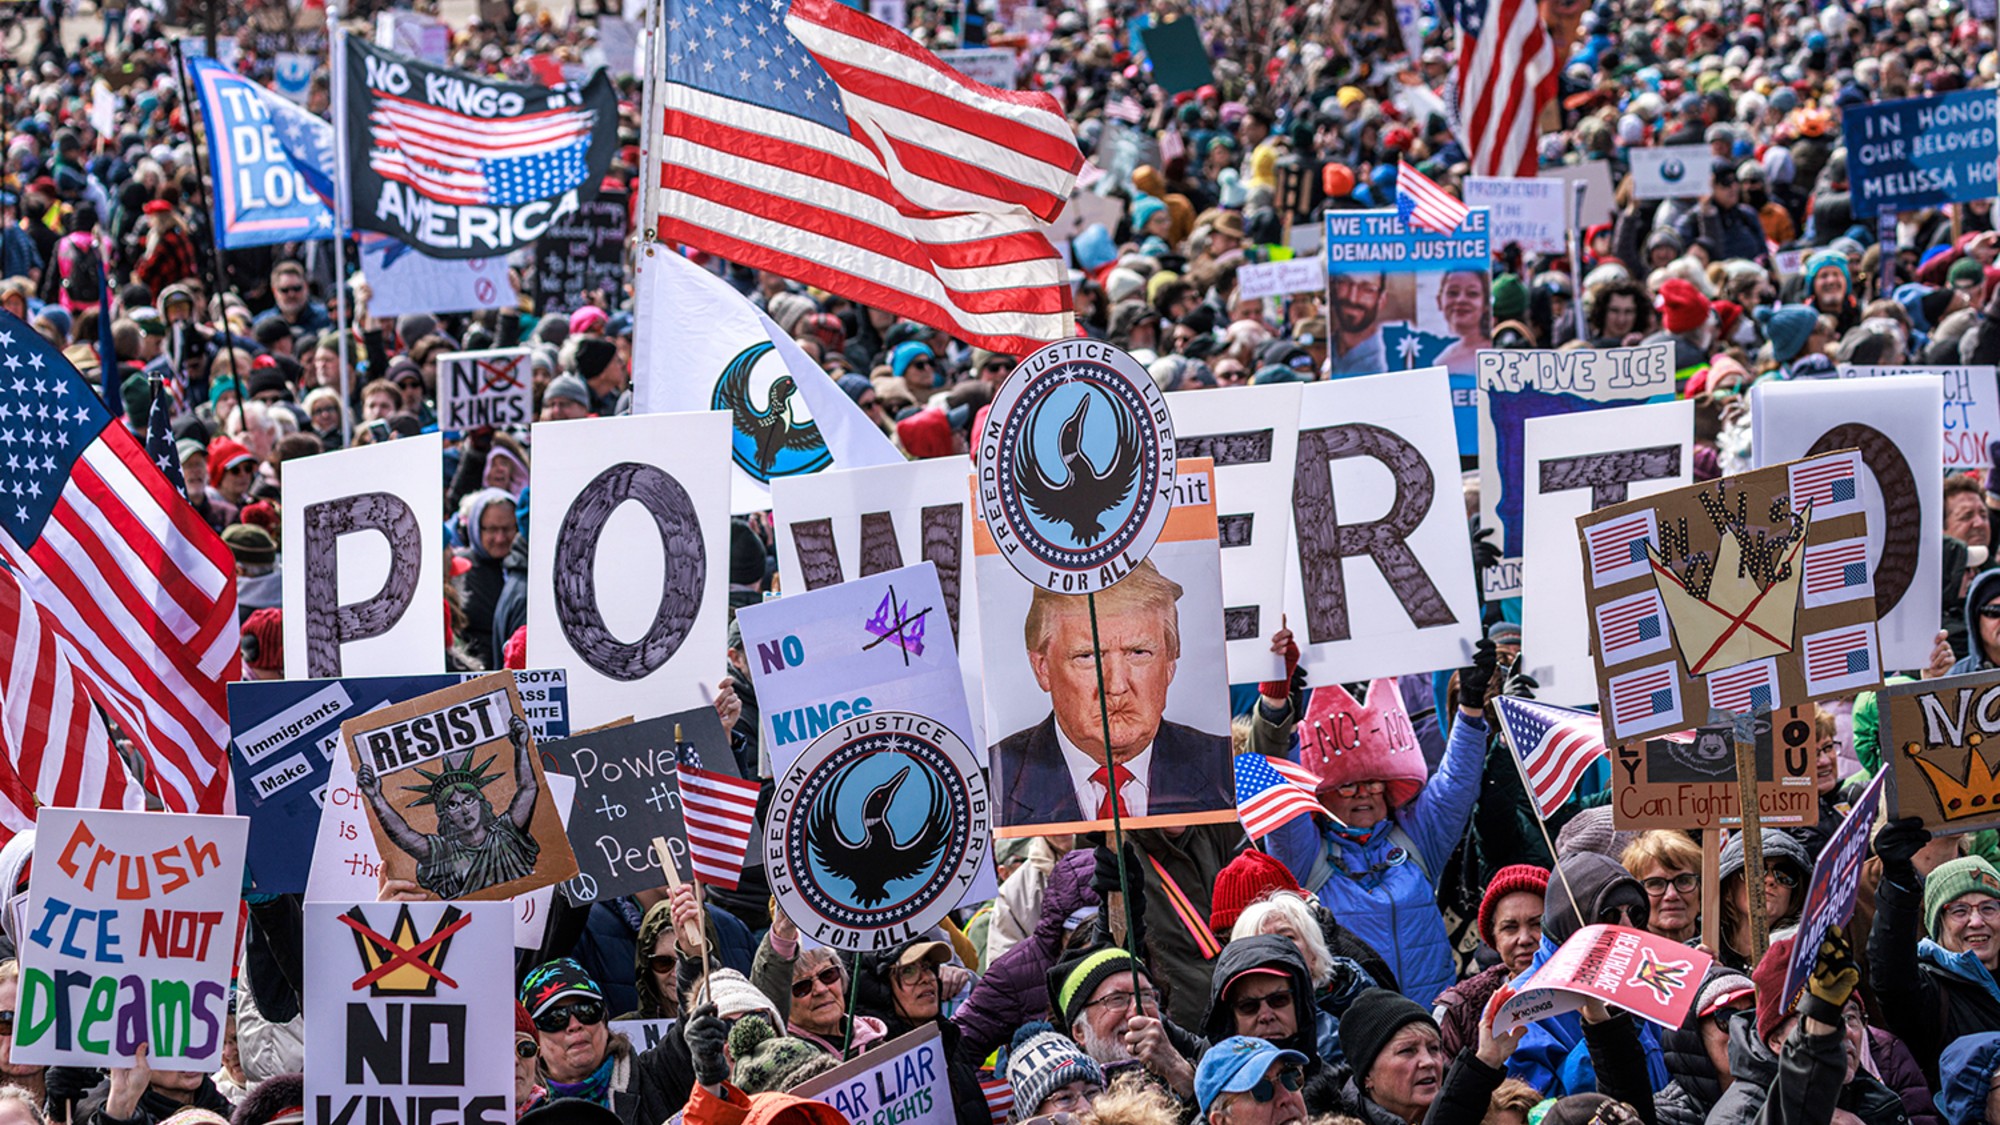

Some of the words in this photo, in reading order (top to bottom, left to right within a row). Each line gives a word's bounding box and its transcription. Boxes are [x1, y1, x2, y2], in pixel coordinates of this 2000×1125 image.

[364, 55, 411, 95] NO
[1864, 113, 1901, 139] IN
[1918, 98, 1997, 129] HONOR
[1859, 139, 1906, 165] OUR
[1913, 128, 1994, 158] BELOVED
[1863, 164, 1957, 200] MELISSA
[377, 184, 580, 250] AMERICA
[1331, 217, 1361, 236] WE
[1365, 216, 1405, 235] THE
[1332, 243, 1406, 261] DEMAND
[1411, 240, 1486, 259] JUSTICE
[452, 357, 518, 397] NO
[1023, 344, 1114, 382] JUSTICE
[1478, 351, 1597, 392] REMOVE
[1606, 345, 1666, 389] ICE
[450, 396, 524, 427] KINGS
[1142, 383, 1174, 502] LIBERTY
[980, 420, 1020, 556] FREEDOM
[1047, 571, 1088, 592] FOR
[1099, 551, 1138, 588] ALL
[757, 634, 805, 675] NO
[244, 699, 342, 758] Immigrants
[367, 698, 495, 772] RESIST
[843, 716, 948, 745] JUSTICE
[259, 762, 308, 793] Make
[571, 748, 677, 788] Powe
[595, 794, 627, 821] to
[645, 782, 682, 812] th
[1620, 786, 1672, 819] Can
[1677, 784, 1733, 826] Fight
[1736, 789, 1811, 819] cism
[339, 821, 358, 841] is
[770, 766, 808, 897] FREEDOM
[958, 772, 987, 891] LIBERTY
[595, 835, 686, 877] Peop
[29, 897, 124, 964] ICE
[139, 908, 224, 962] NOT
[814, 921, 861, 949] FOR
[872, 920, 919, 950] ALL
[1796, 863, 1860, 969] AMERICA
[1593, 931, 1642, 994] HEALTHCARE
[346, 1003, 467, 1087] NO
[875, 1046, 936, 1107] LIAR
[872, 1086, 933, 1125] RIGHTS
